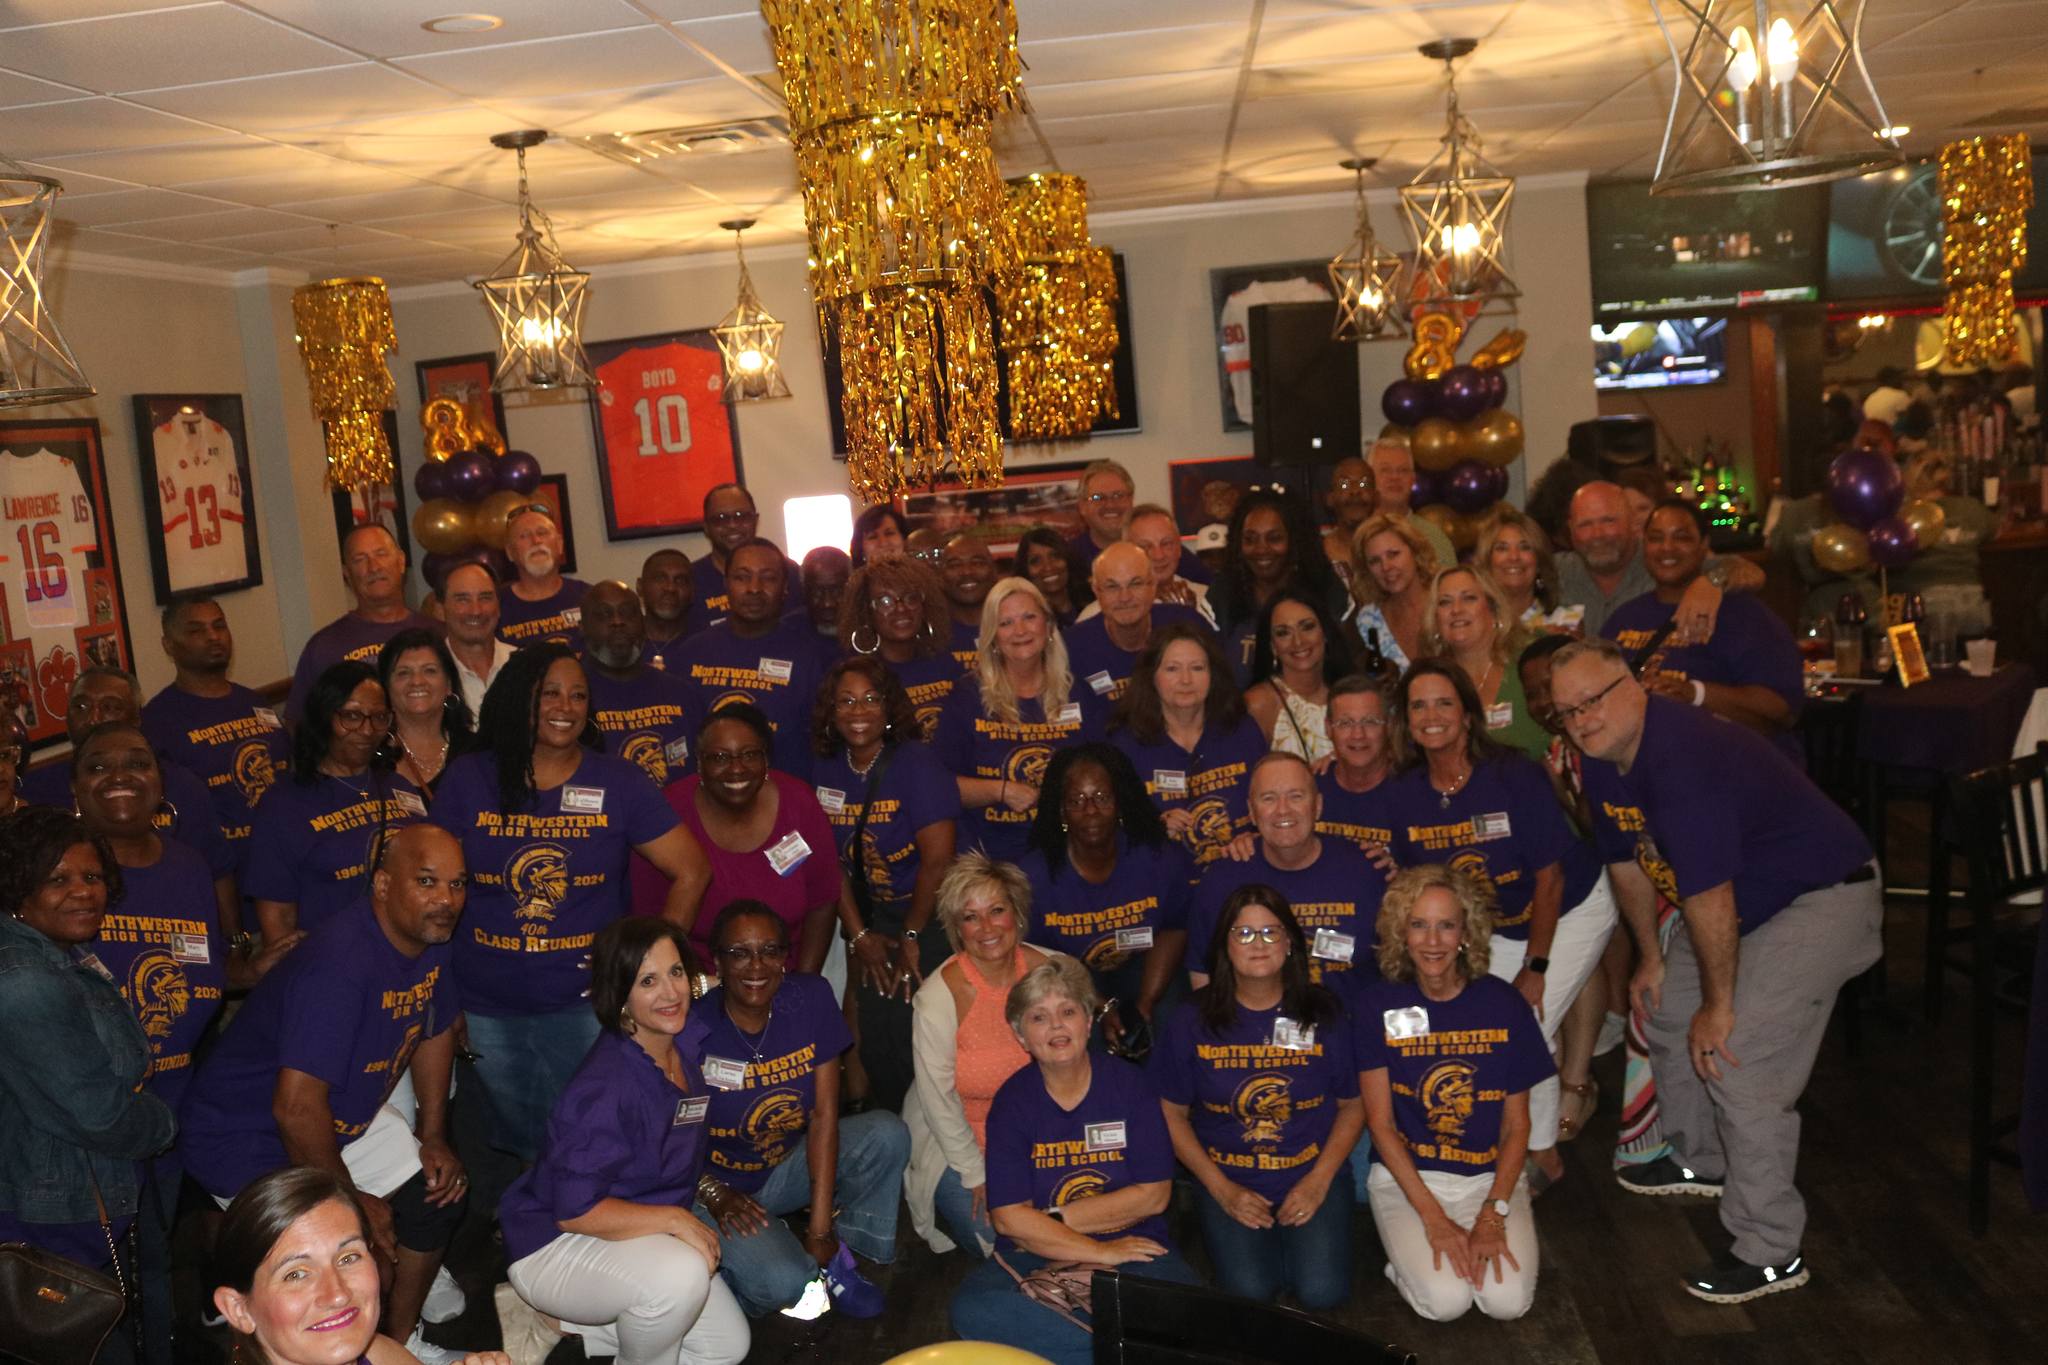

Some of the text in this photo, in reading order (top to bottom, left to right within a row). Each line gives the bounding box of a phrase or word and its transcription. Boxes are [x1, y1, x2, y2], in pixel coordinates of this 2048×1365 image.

[641, 367, 677, 389] BOYD
[634, 395, 692, 456] 10
[160, 476, 177, 503] 13
[4, 493, 61, 520] LAWRENCE
[72, 495, 90, 523] 16
[185, 484, 221, 550] 13
[17, 521, 68, 602] 16
[596, 704, 683, 722] ORTHWESTERN
[531, 828, 591, 838] SCHOOL
[1044, 896, 1159, 927] NORTHWESTERN
[101, 930, 173, 945] HIGH SCH
[473, 927, 521, 951] CLASS
[1060, 925, 1093, 936] HIGH
[1253, 1056, 1310, 1069] SCHOOL
[761, 1064, 814, 1087] SCHOOL
[1070, 1151, 1125, 1166] SCHOOL
